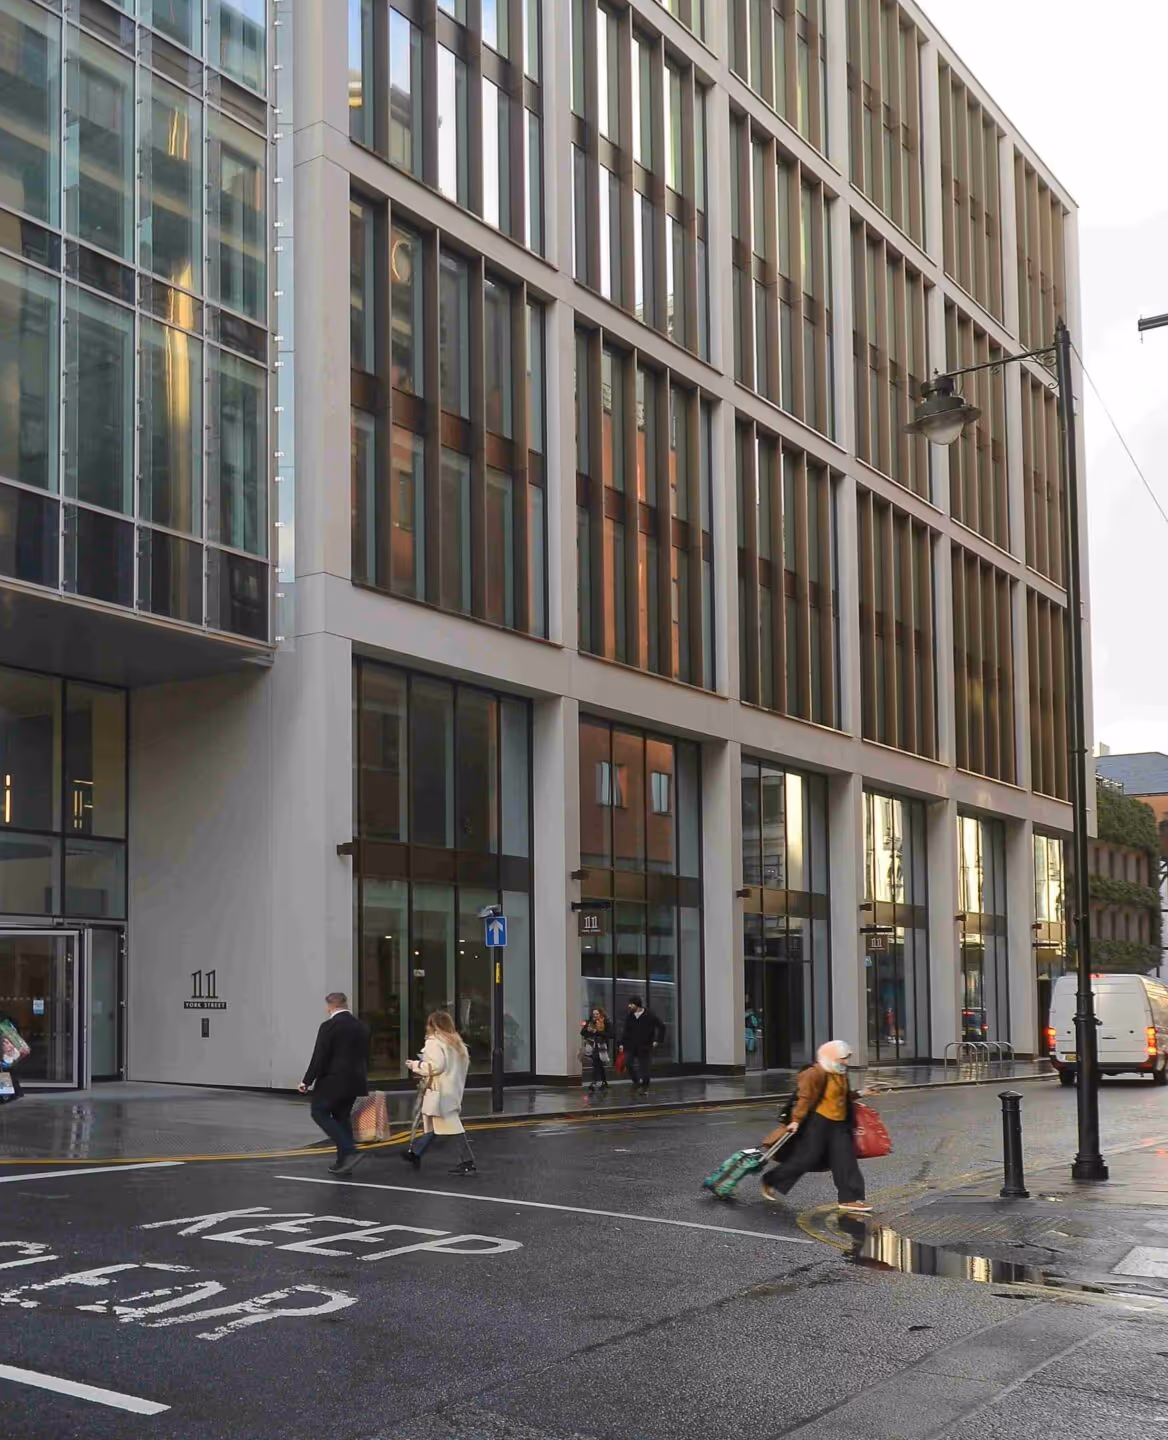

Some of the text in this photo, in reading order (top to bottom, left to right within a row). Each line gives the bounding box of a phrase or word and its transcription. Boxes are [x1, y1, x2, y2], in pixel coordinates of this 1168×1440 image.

[584, 915, 598, 929] 11
[871, 937, 882, 947] 11
[191, 969, 219, 999] 11
[136, 1206, 524, 1260] KEEP
